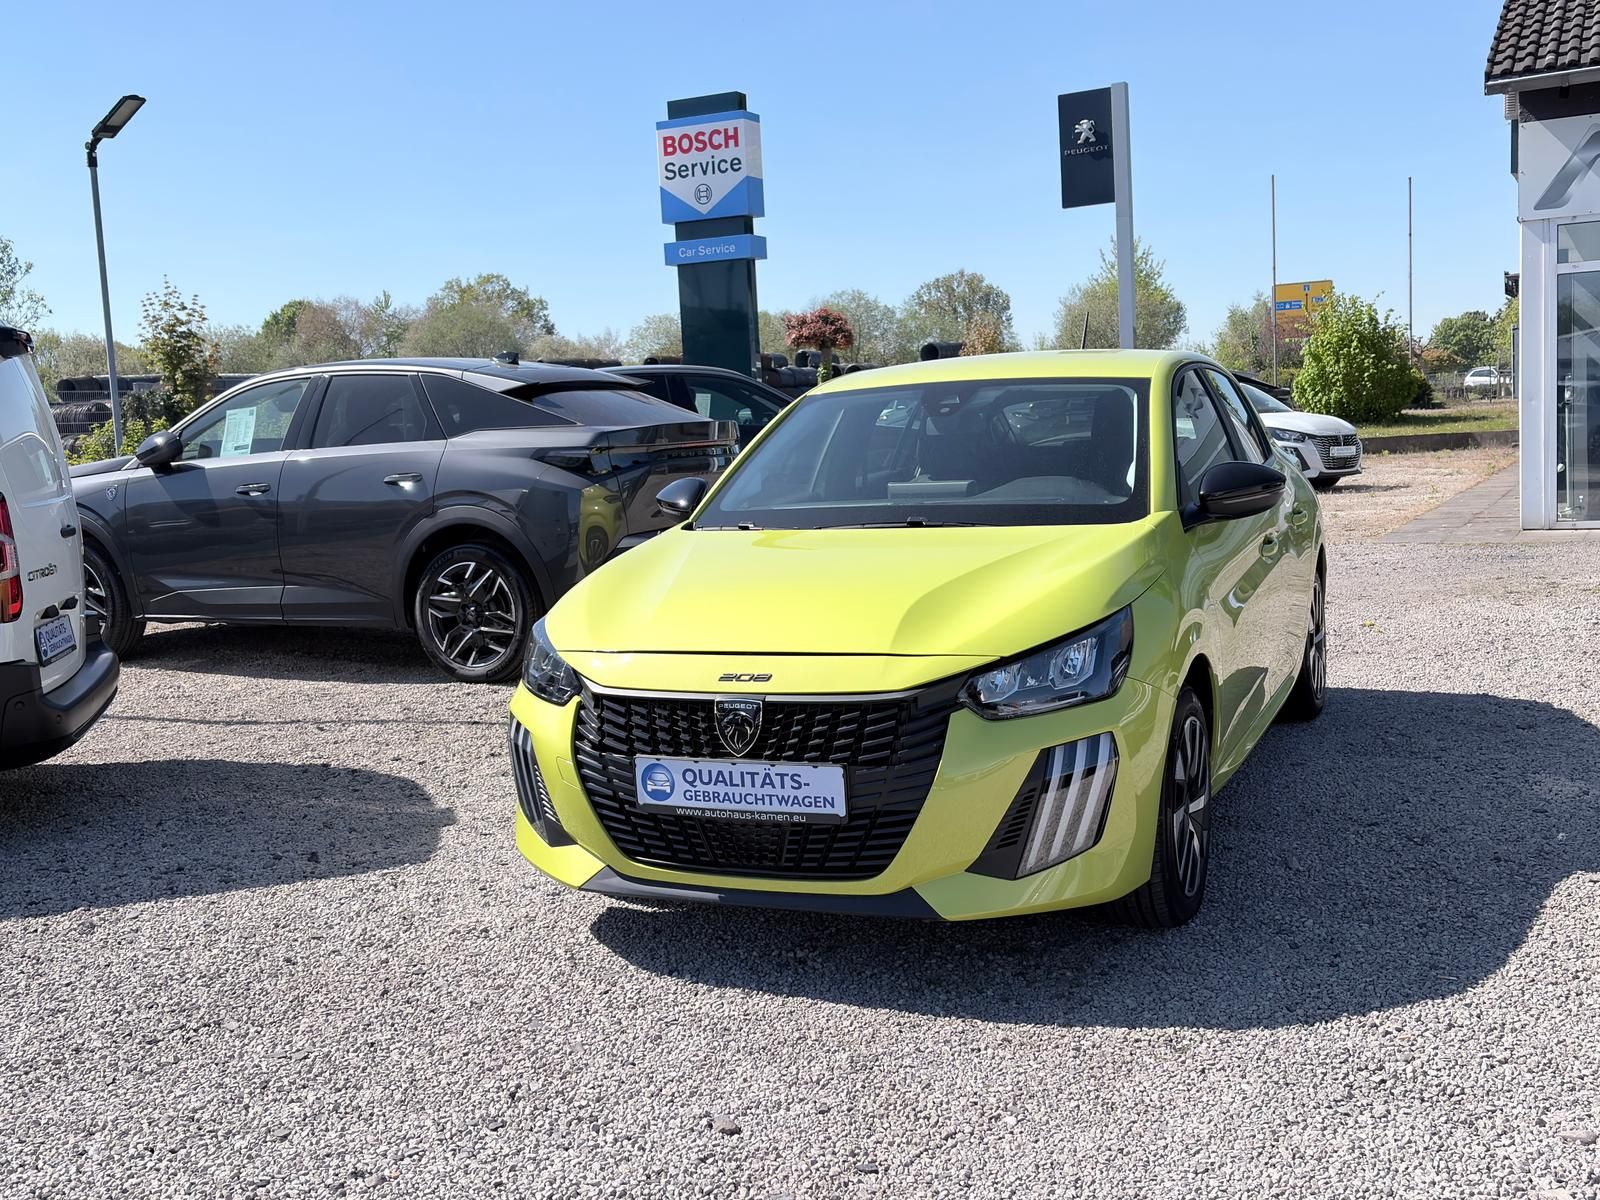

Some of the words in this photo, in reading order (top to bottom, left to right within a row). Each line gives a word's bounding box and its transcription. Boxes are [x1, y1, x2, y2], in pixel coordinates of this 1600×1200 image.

[662, 127, 740, 157] BOSCH
[1064, 144, 1109, 156] PEUGEOT
[664, 155, 742, 181] Service
[678, 247, 696, 258] Car
[698, 243, 736, 256] Service
[718, 673, 773, 682] 208
[681, 768, 811, 791] QUALITÄTS-
[683, 789, 835, 809] GEBRAUCHTWAGEN
[676, 807, 806, 823] www.autohaus-kamen.eu
